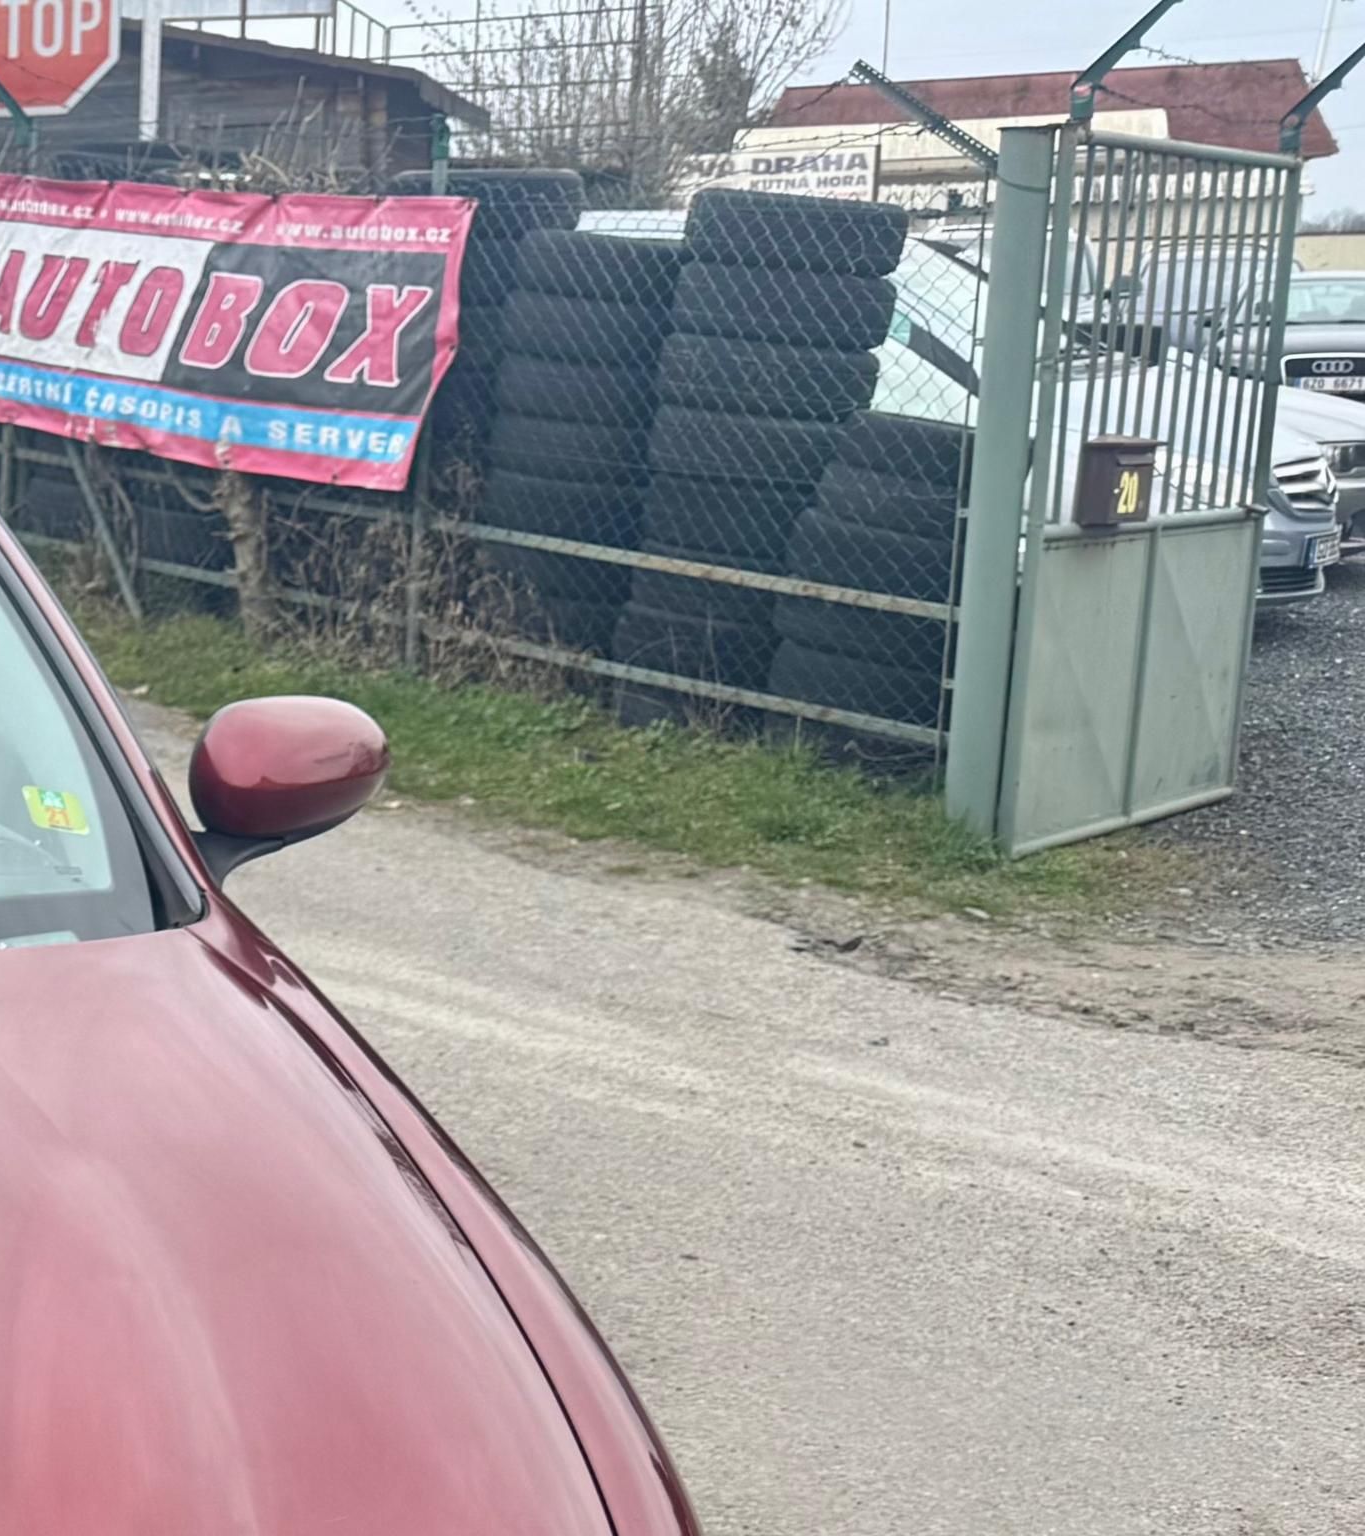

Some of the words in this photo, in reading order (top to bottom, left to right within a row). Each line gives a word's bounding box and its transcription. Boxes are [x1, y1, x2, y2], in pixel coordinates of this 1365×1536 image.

[220, 414, 243, 438] A
[268, 419, 407, 455] SERVER
[1116, 470, 1139, 514] 20
